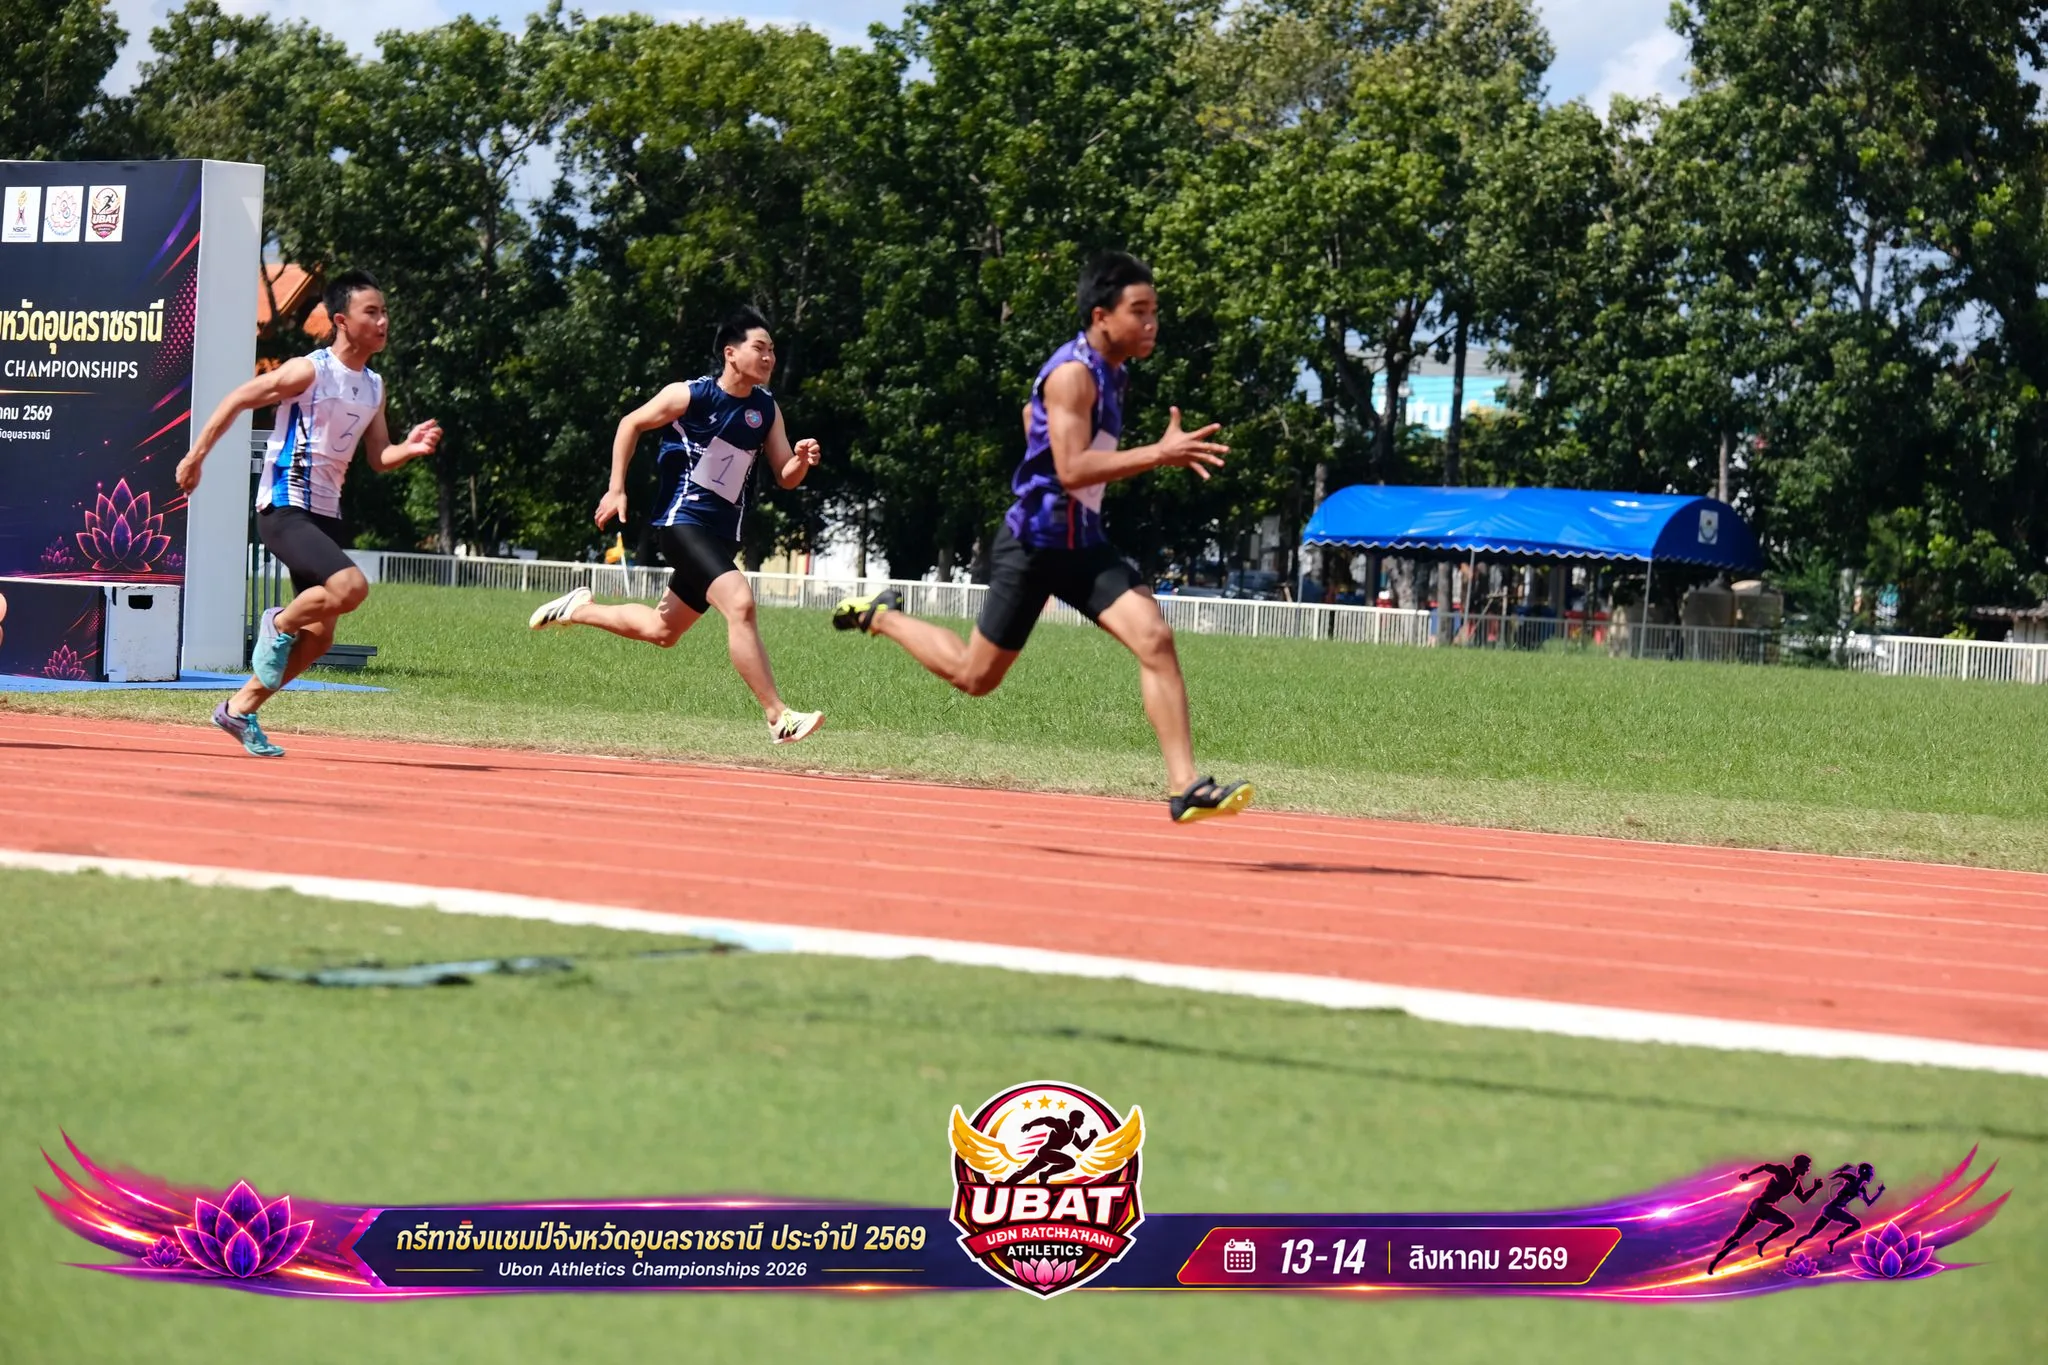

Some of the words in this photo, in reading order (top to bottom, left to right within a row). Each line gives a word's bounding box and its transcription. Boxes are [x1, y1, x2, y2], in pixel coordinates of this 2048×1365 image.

[0, 298, 164, 355] หวัดอุบลราชธานี
[4, 360, 138, 379] CHAMPIONSHIPS
[22, 404, 53, 421] 2569
[712, 454, 734, 486] 1
